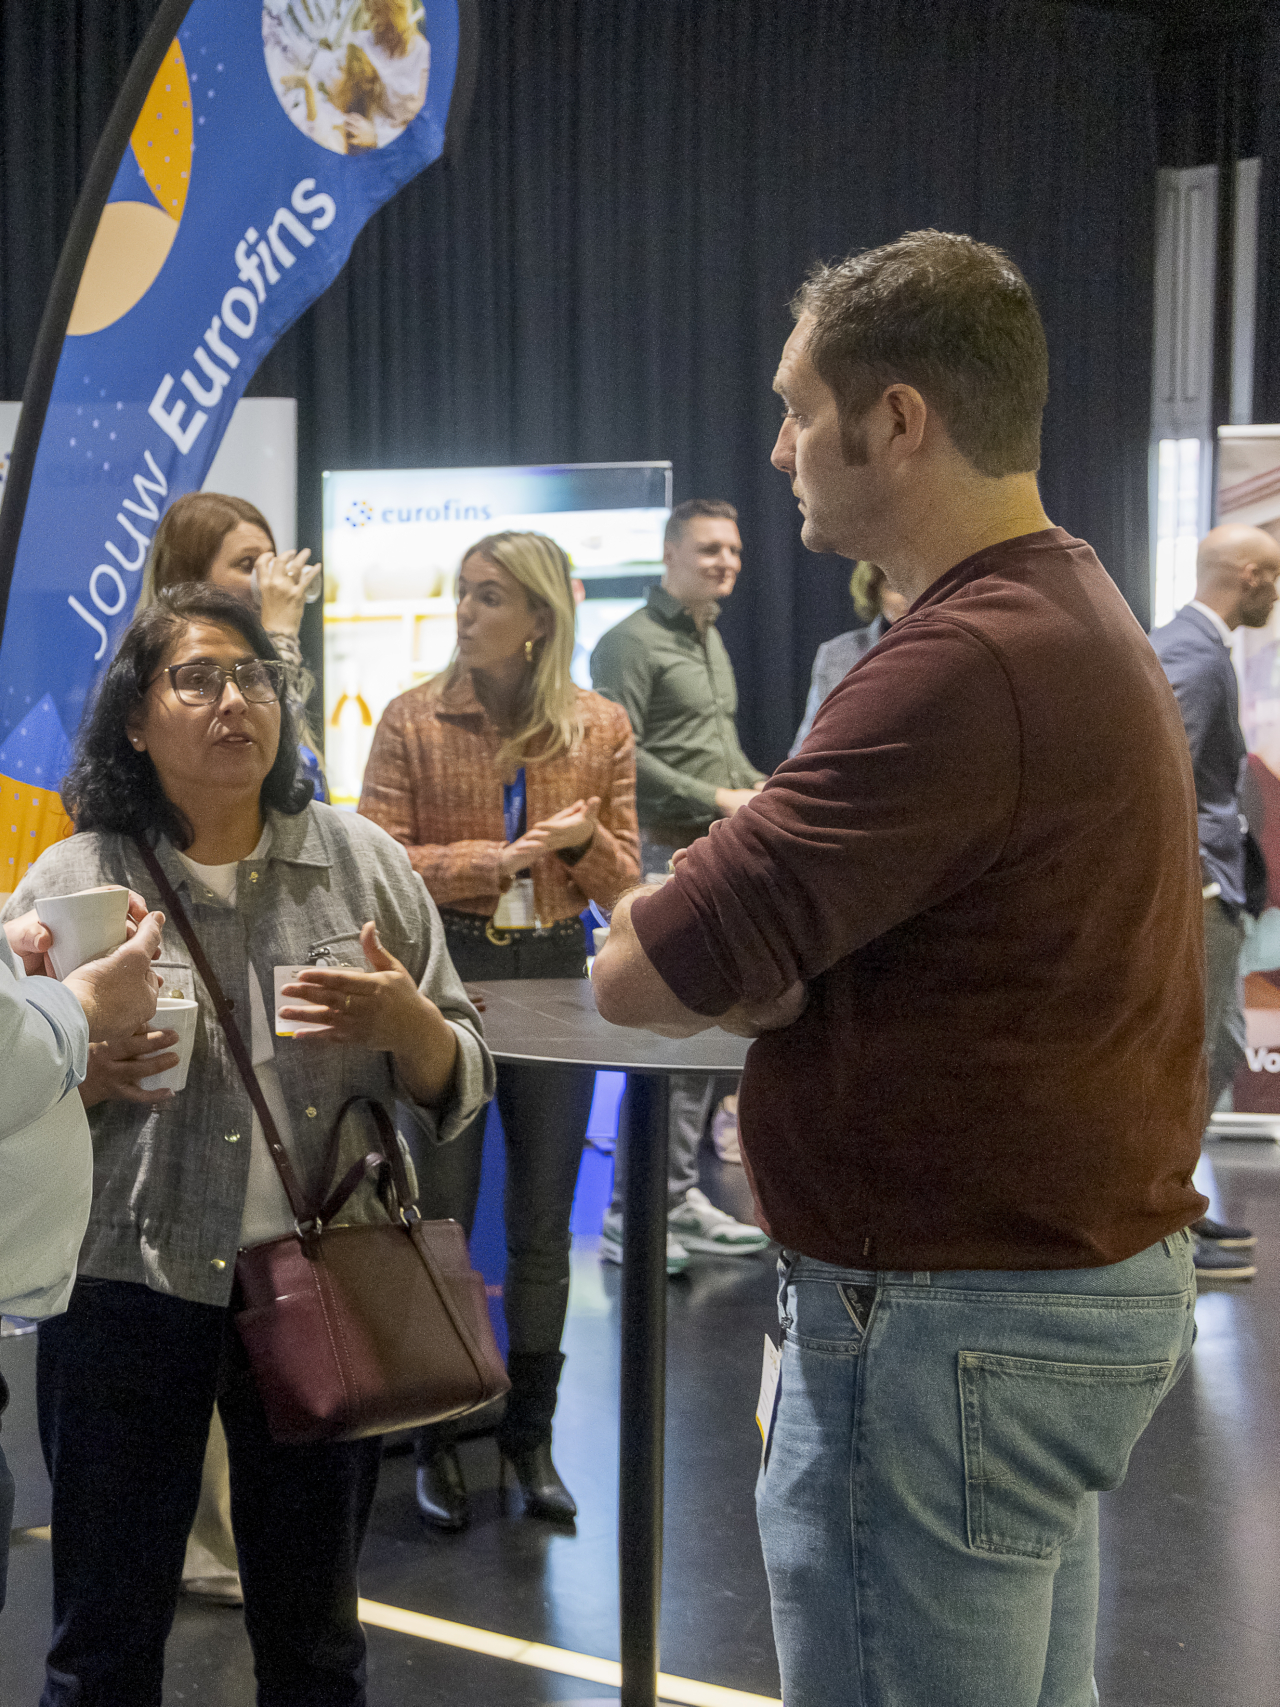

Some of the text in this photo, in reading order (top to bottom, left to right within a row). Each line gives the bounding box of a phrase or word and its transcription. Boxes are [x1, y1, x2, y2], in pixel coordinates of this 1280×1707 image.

[148, 177, 337, 455] Eurofins
[381, 498, 492, 524] eurofins
[1245, 1046, 1280, 1074] Vo
